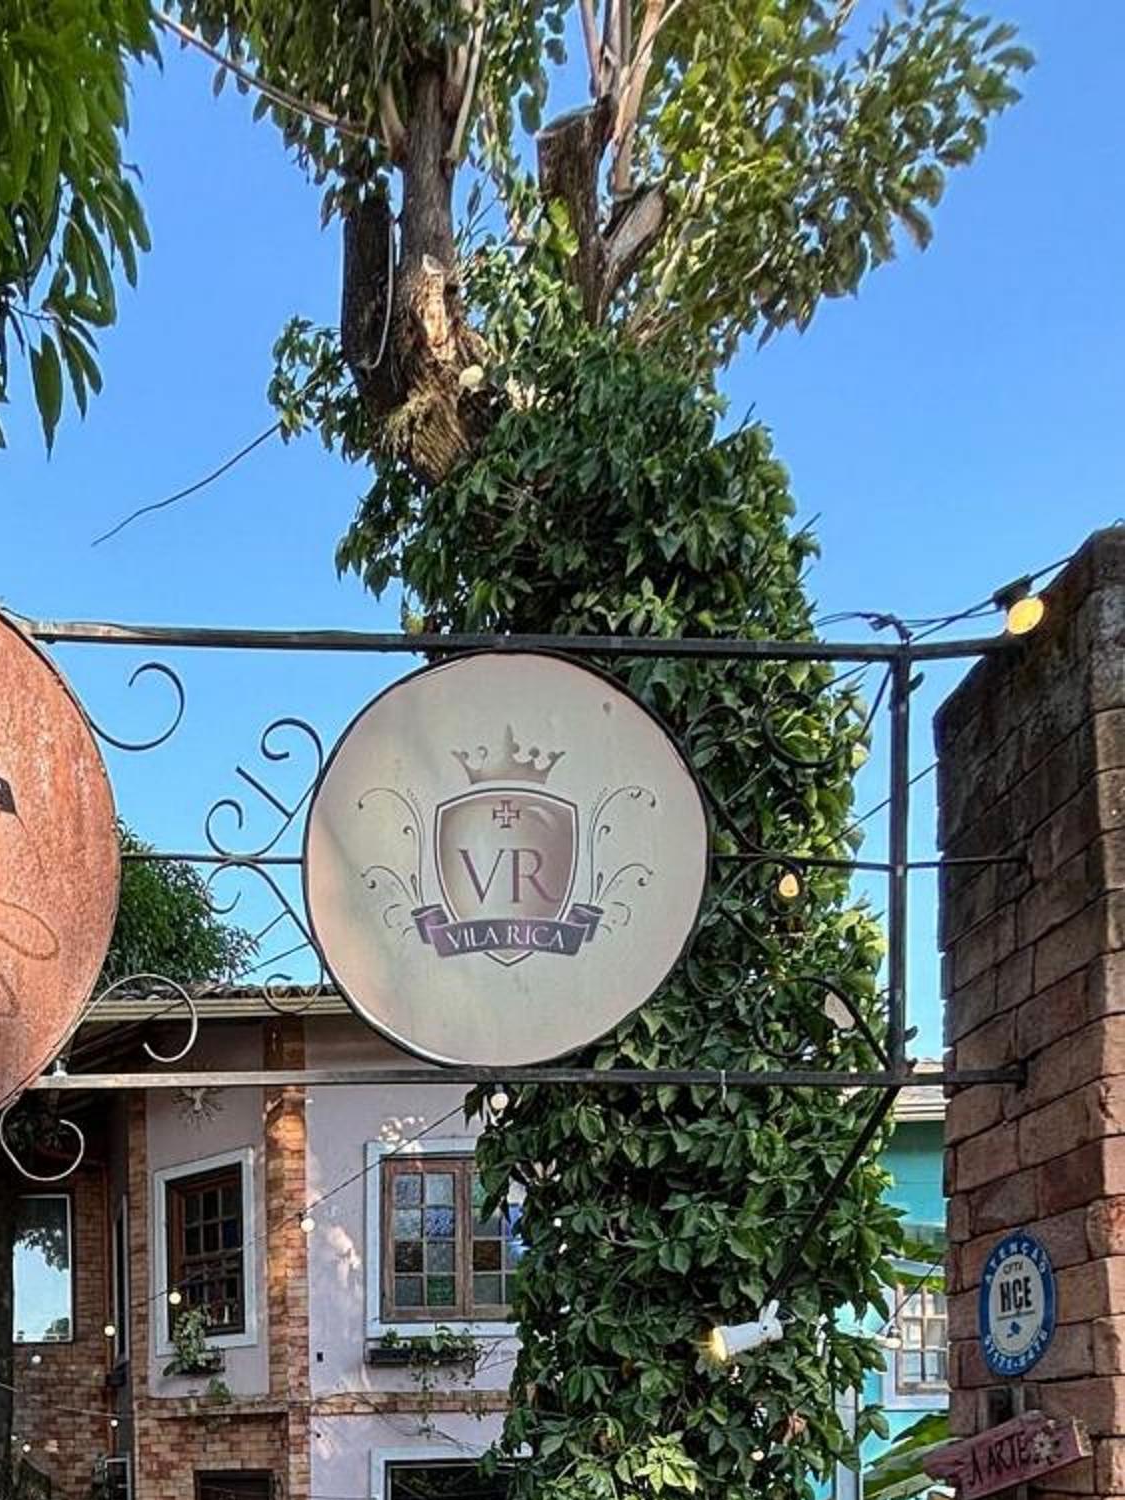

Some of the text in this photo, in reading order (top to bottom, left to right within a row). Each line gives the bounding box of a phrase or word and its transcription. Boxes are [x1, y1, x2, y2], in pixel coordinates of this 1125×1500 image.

[458, 847, 563, 904] VR
[446, 924, 565, 950] VILA RICA
[969, 1431, 1031, 1487] A ARTE
